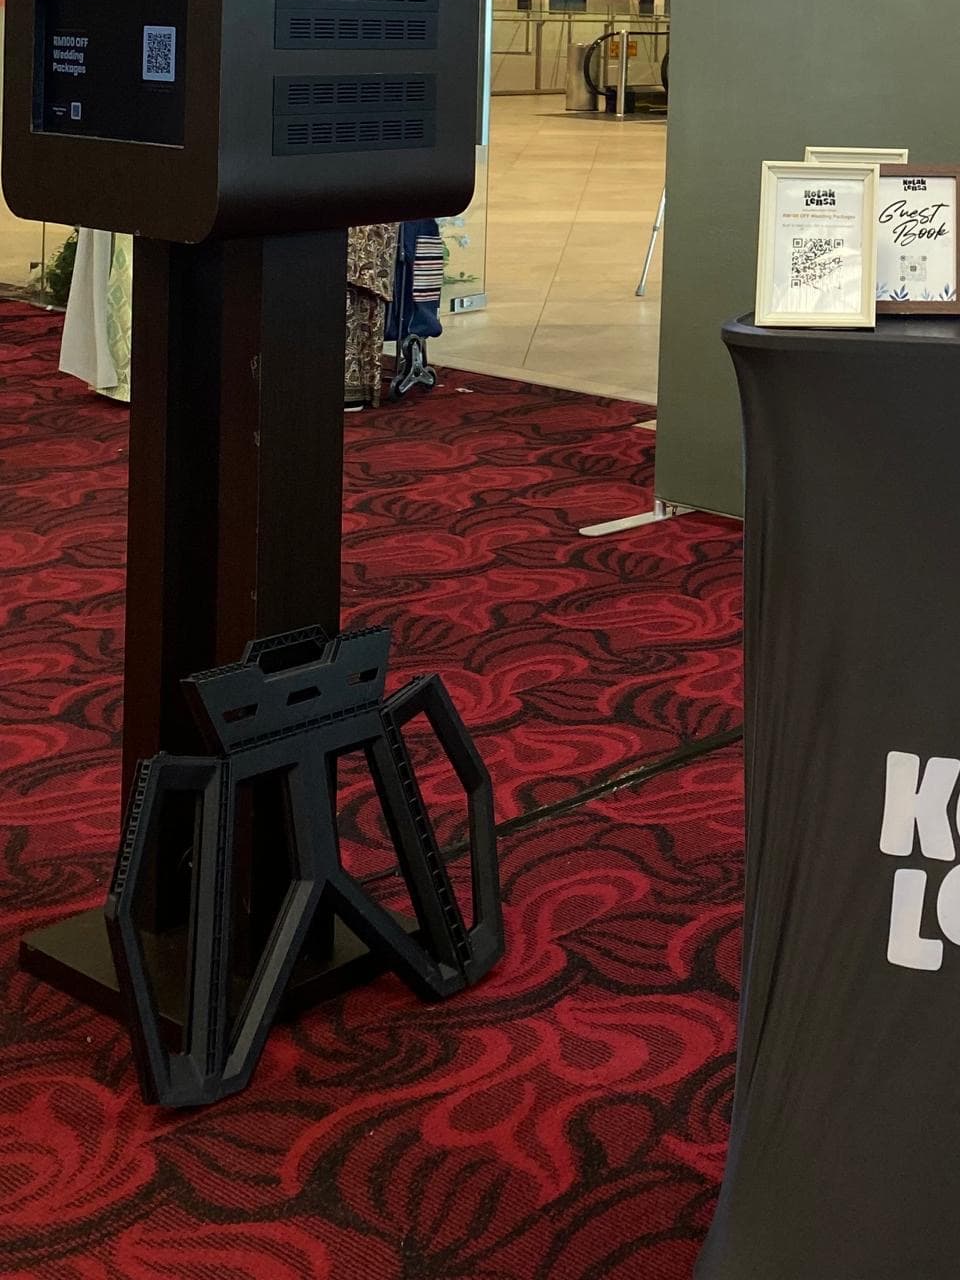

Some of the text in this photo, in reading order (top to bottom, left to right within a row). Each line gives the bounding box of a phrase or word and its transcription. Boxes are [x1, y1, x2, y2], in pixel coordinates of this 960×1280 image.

[75, 37, 88, 48] OFF
[53, 49, 84, 63] Wedding
[52, 62, 86, 76] Packages
[804, 189, 836, 199] Kotak
[805, 197, 836, 207] Lensa
[893, 219, 950, 247] Book
